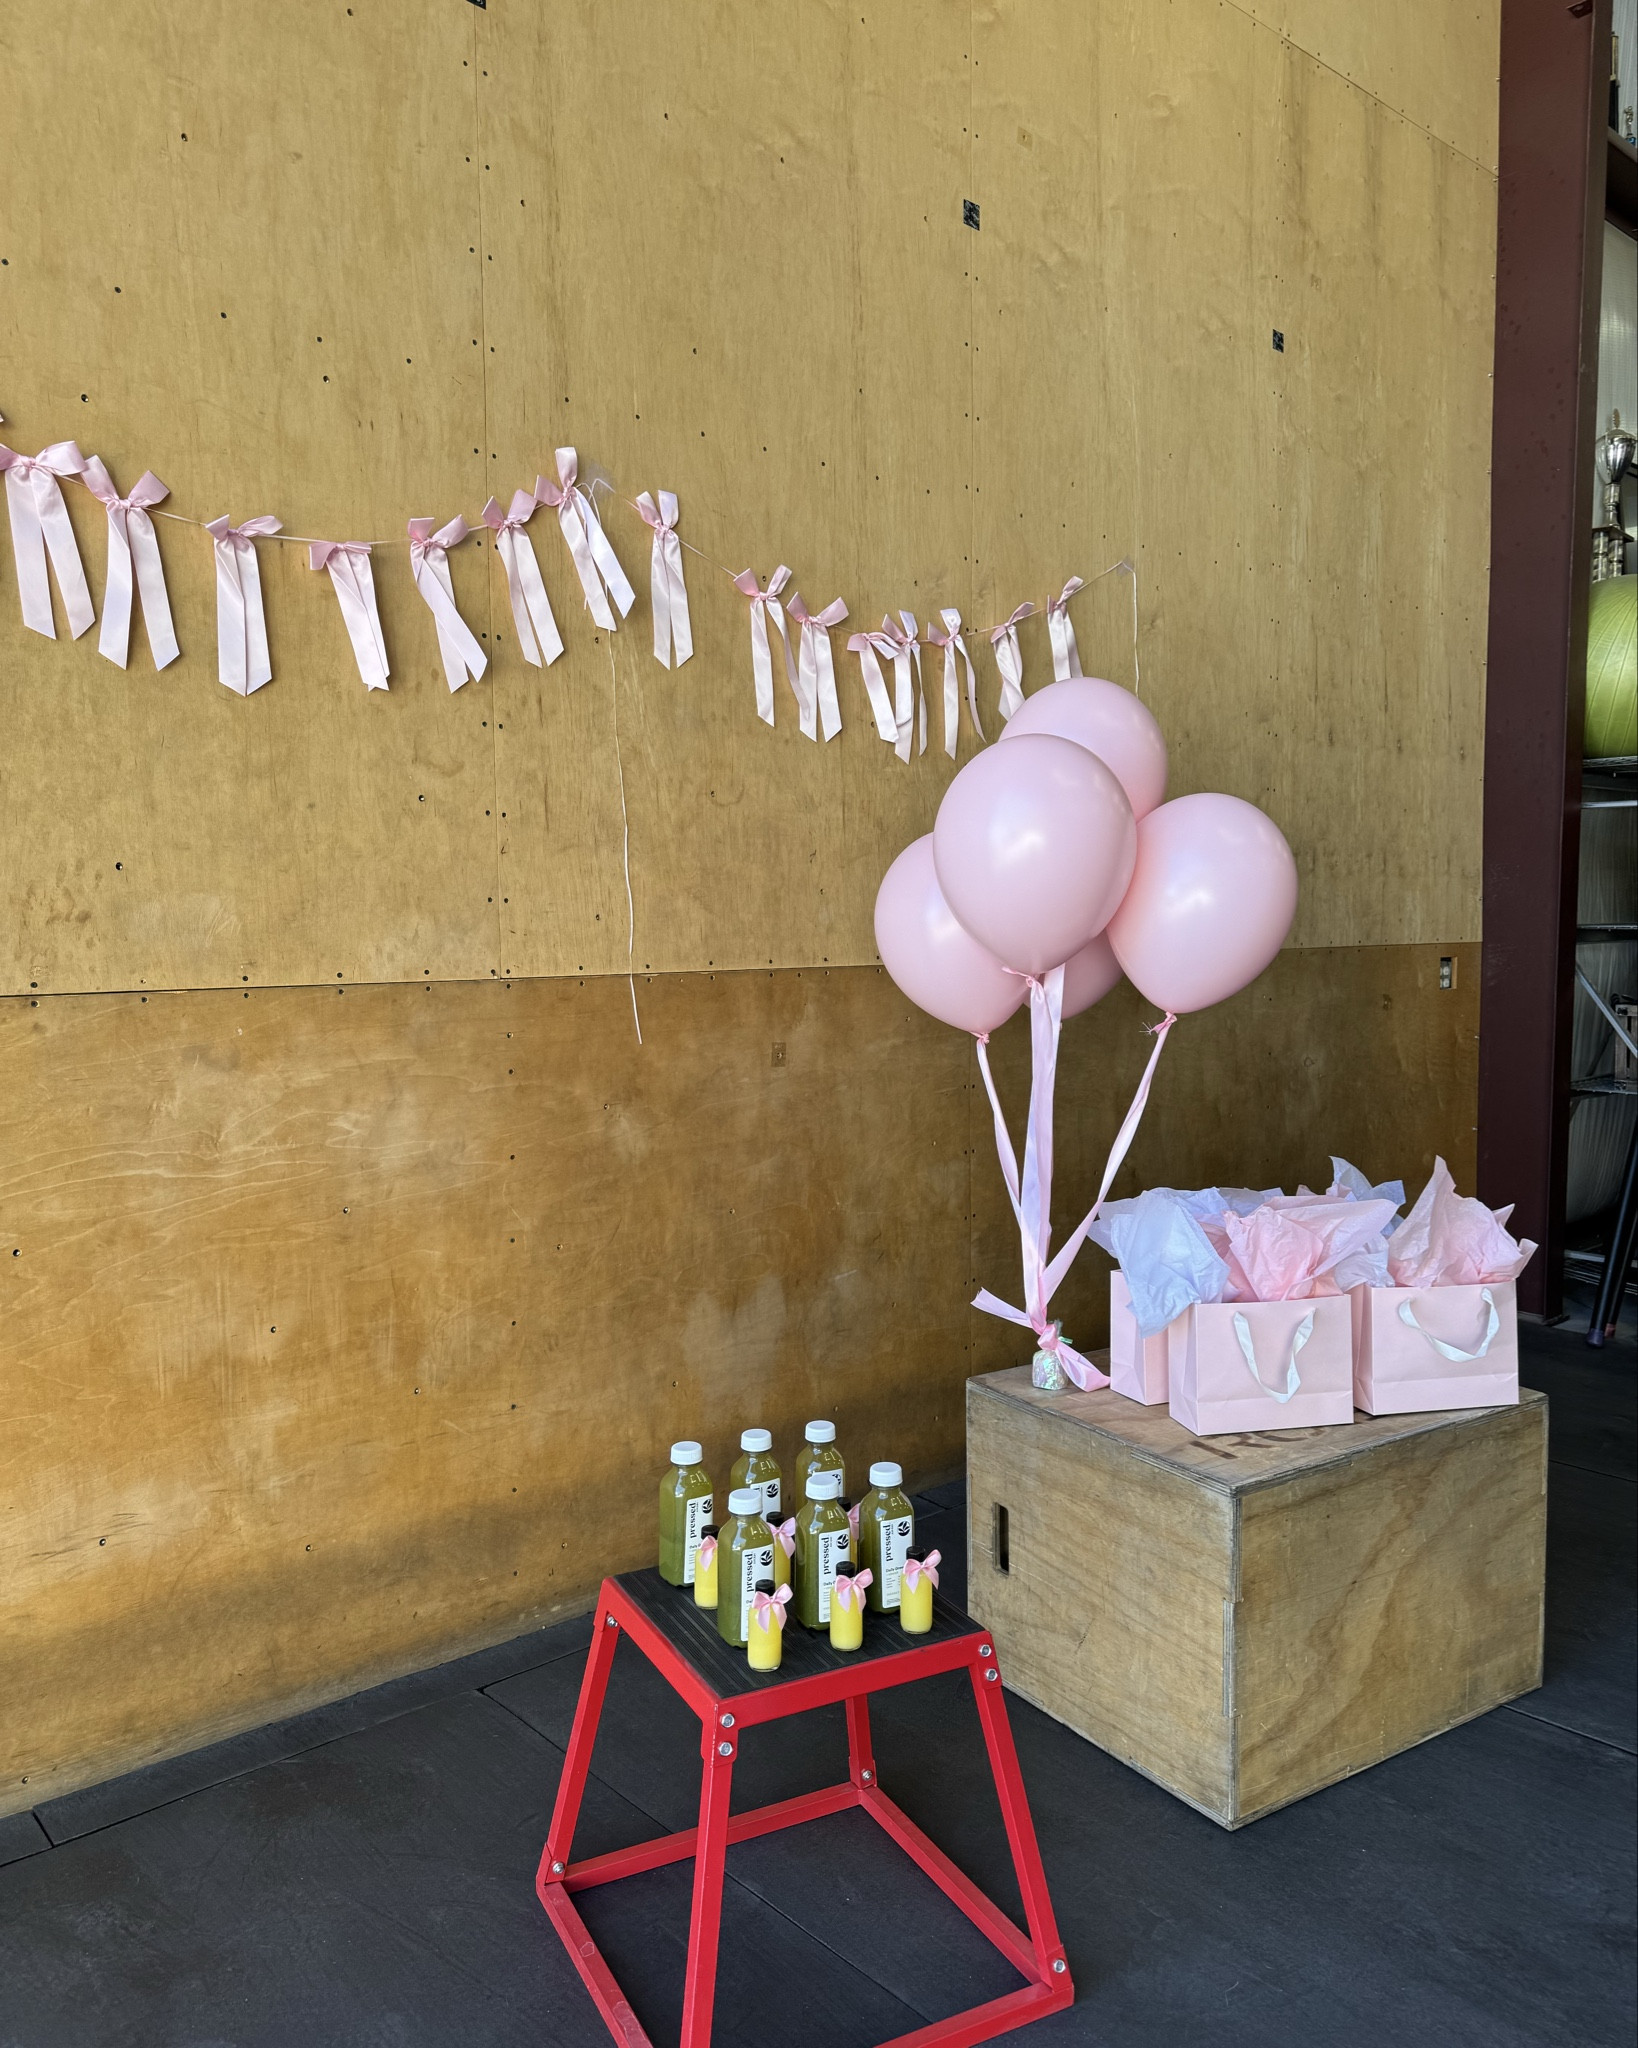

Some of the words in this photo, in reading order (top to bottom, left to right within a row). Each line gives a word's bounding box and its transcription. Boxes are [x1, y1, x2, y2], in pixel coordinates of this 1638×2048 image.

[689, 1502, 697, 1538] pressed
[821, 1536, 831, 1575] pressed
[883, 1524, 893, 1562] pressed
[744, 1553, 754, 1592] pressed
